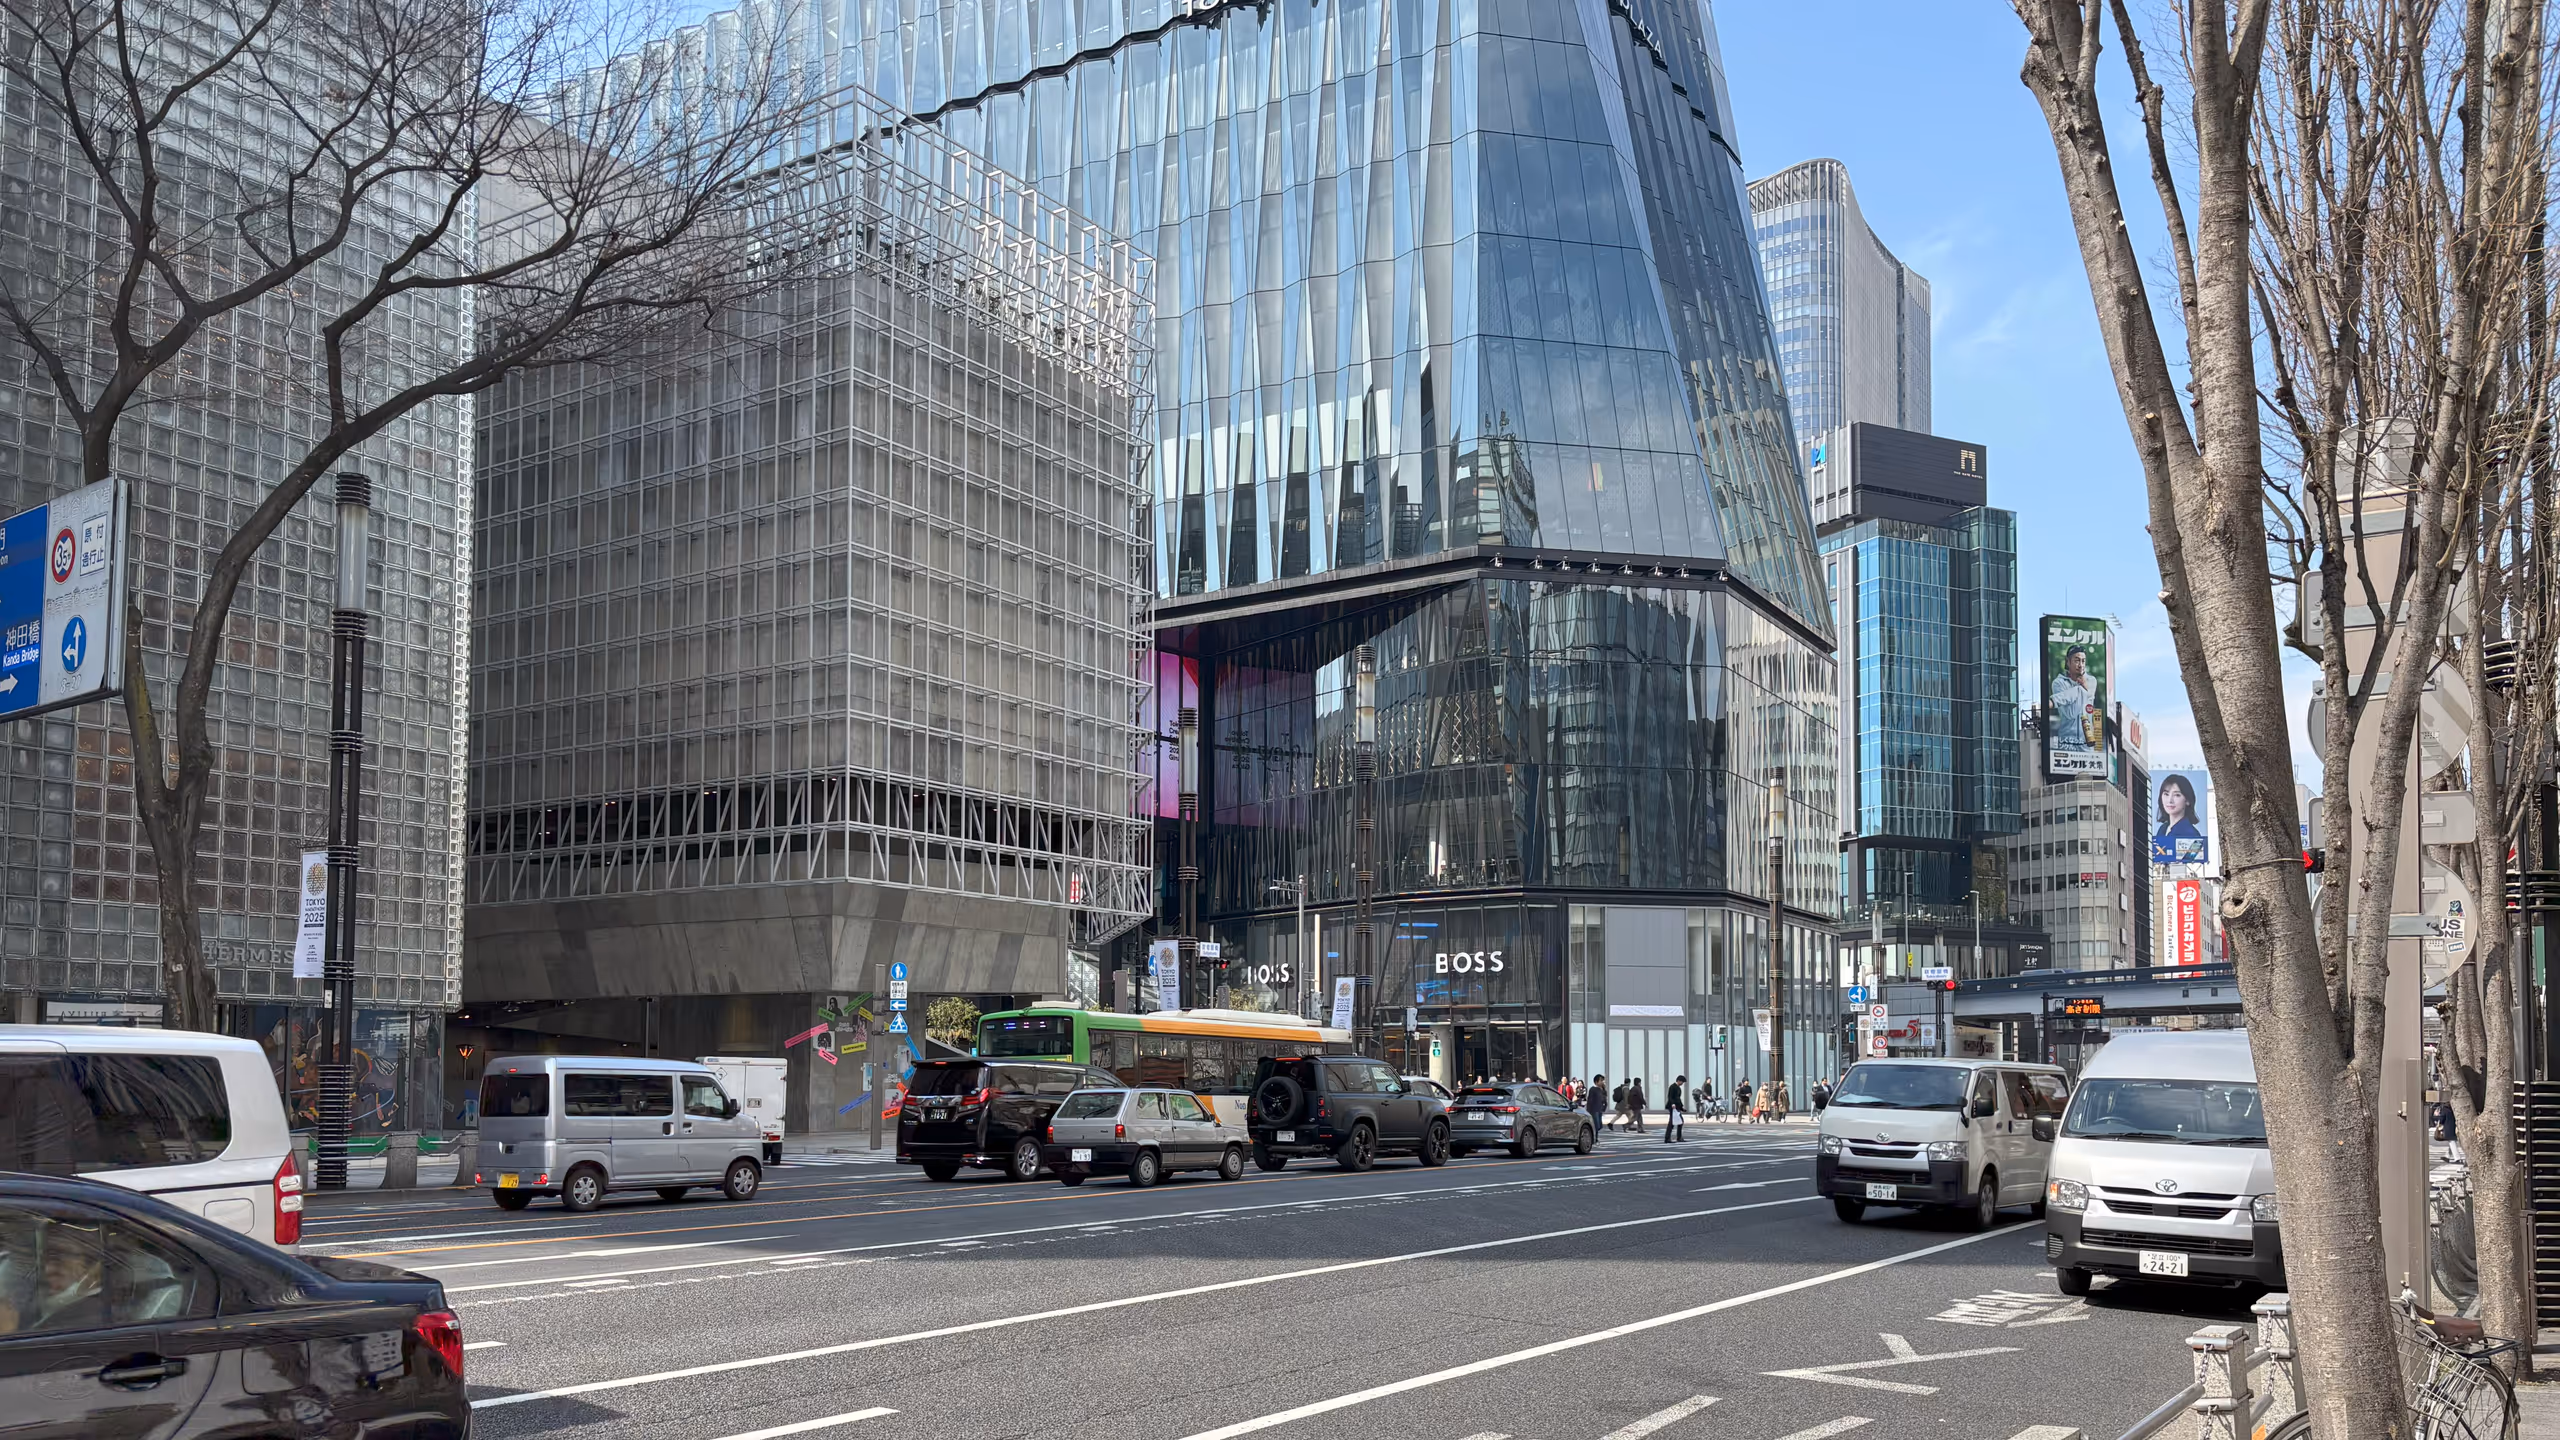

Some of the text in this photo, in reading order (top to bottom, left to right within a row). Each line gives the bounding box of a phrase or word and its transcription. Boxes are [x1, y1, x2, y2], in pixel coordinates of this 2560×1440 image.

[84, 524, 104, 543] 原付
[82, 549, 104, 568] 通行止
[6, 620, 40, 651] 神田橋
[2048, 627, 2105, 645] ユンケル
[3, 647, 39, 668] Kanda Bridge
[305, 898, 325, 906] TOKYO
[304, 912, 325, 922] 2025
[2183, 904, 2195, 962] ビックカメラ
[1436, 950, 1504, 974] BOSS
[1248, 963, 1289, 985] BOSS
[2066, 1004, 2101, 1014] 高さ制限
[1873, 1190, 1895, 1198] 50-14
[2150, 1261, 2183, 1274] 24-21
